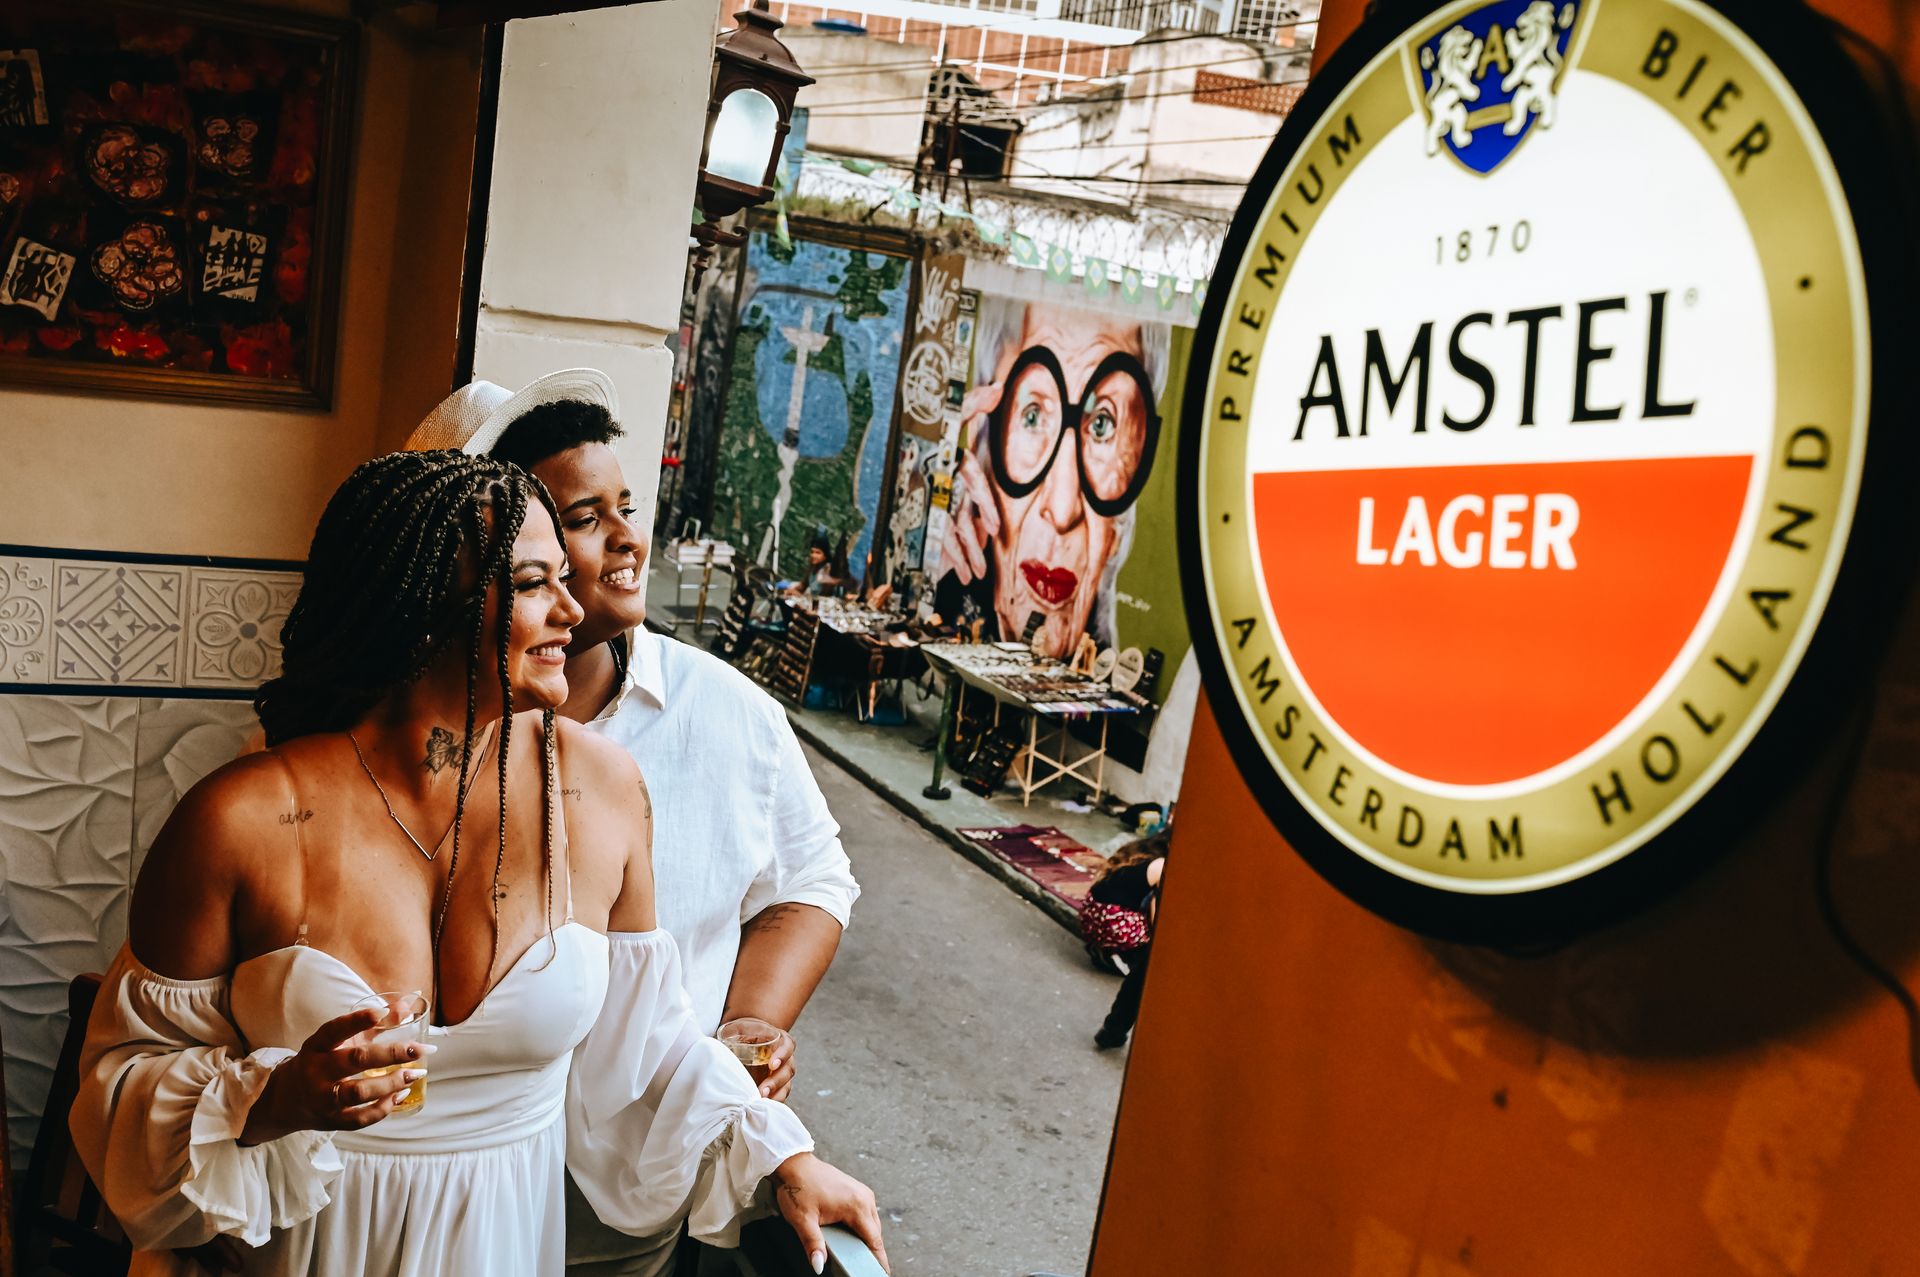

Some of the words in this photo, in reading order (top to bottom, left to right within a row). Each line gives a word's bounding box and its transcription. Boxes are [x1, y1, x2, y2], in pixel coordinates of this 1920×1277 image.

[1476, 24, 1509, 79] A
[1220, 113, 1365, 423] PREMIUM
[1642, 28, 1772, 175] BIER
[1436, 220, 1532, 266] 1870
[1291, 291, 1697, 442] AMSTEL
[1356, 493, 1581, 570] LAGER
[1231, 616, 1526, 861] AMSTERDAM
[1591, 427, 1831, 826] HOLLAND
